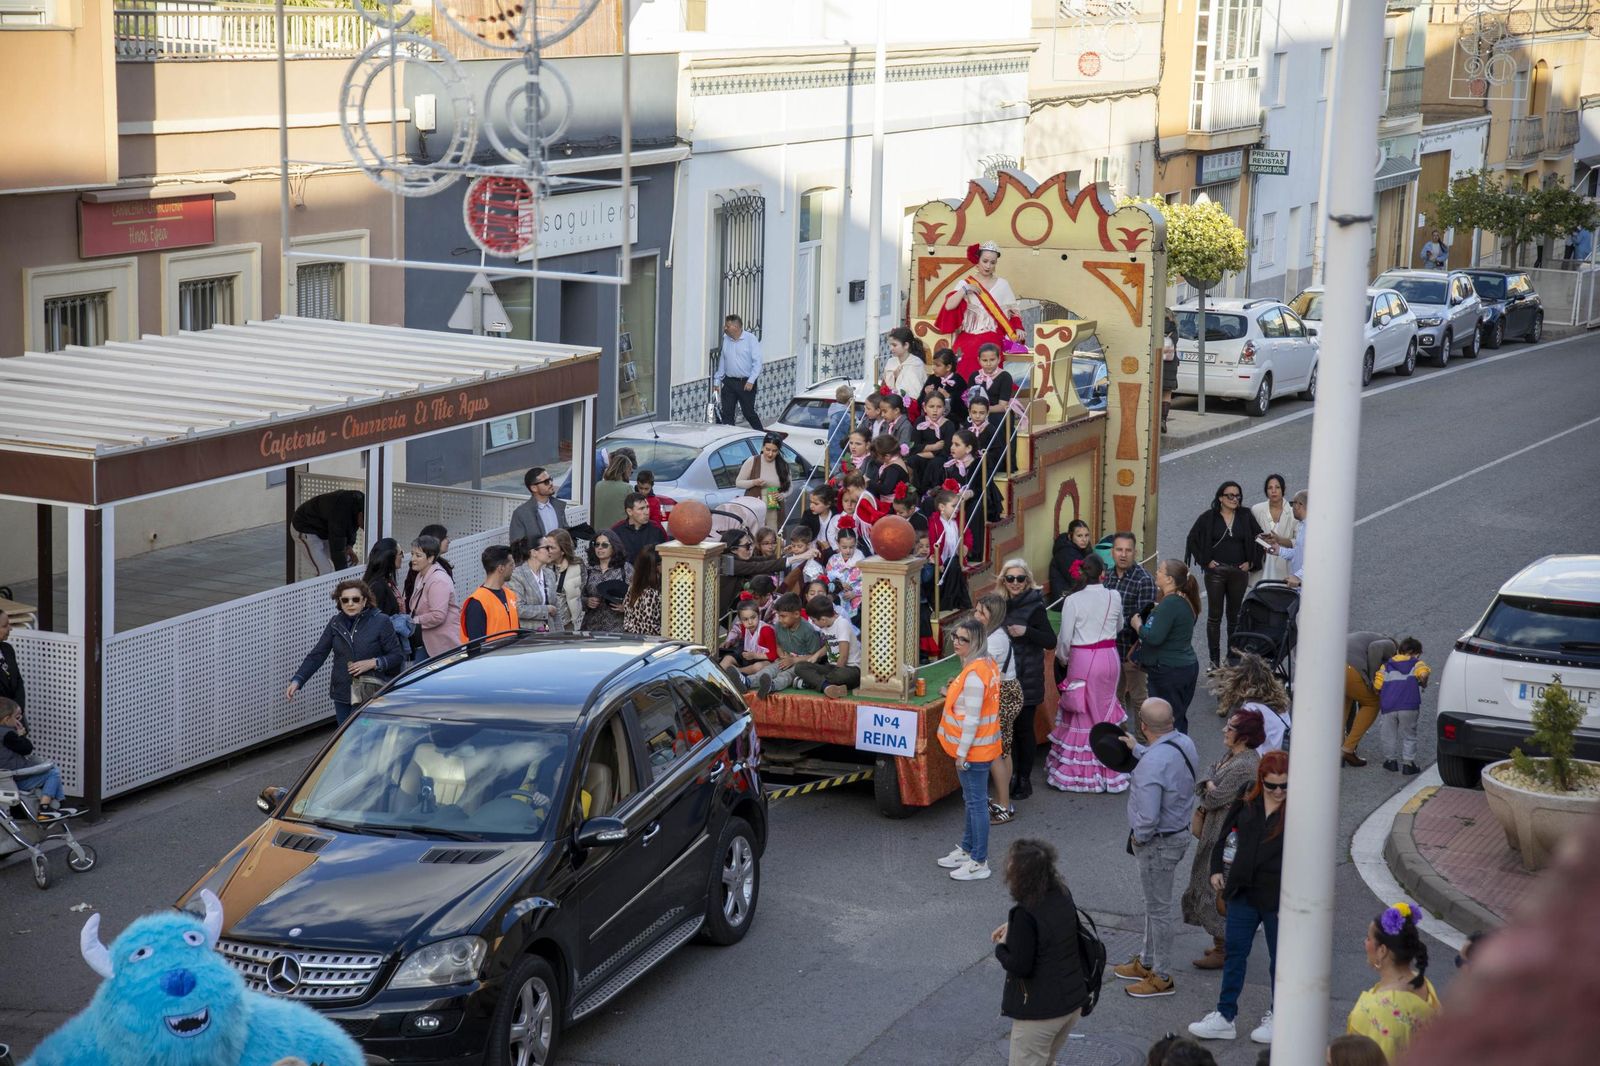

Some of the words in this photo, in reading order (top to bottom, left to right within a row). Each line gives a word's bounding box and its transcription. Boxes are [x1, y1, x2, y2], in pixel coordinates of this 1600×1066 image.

[1252, 150, 1279, 158] PRENSA
[1252, 157, 1285, 165] REVISTAS
[1249, 165, 1272, 173] RECARGAS
[260, 426, 327, 461] Cafetería
[342, 409, 407, 440] Churrería
[414, 400, 429, 425] El
[431, 395, 455, 421] Tite
[459, 391, 490, 421] Agus
[863, 730, 908, 749] REINA
